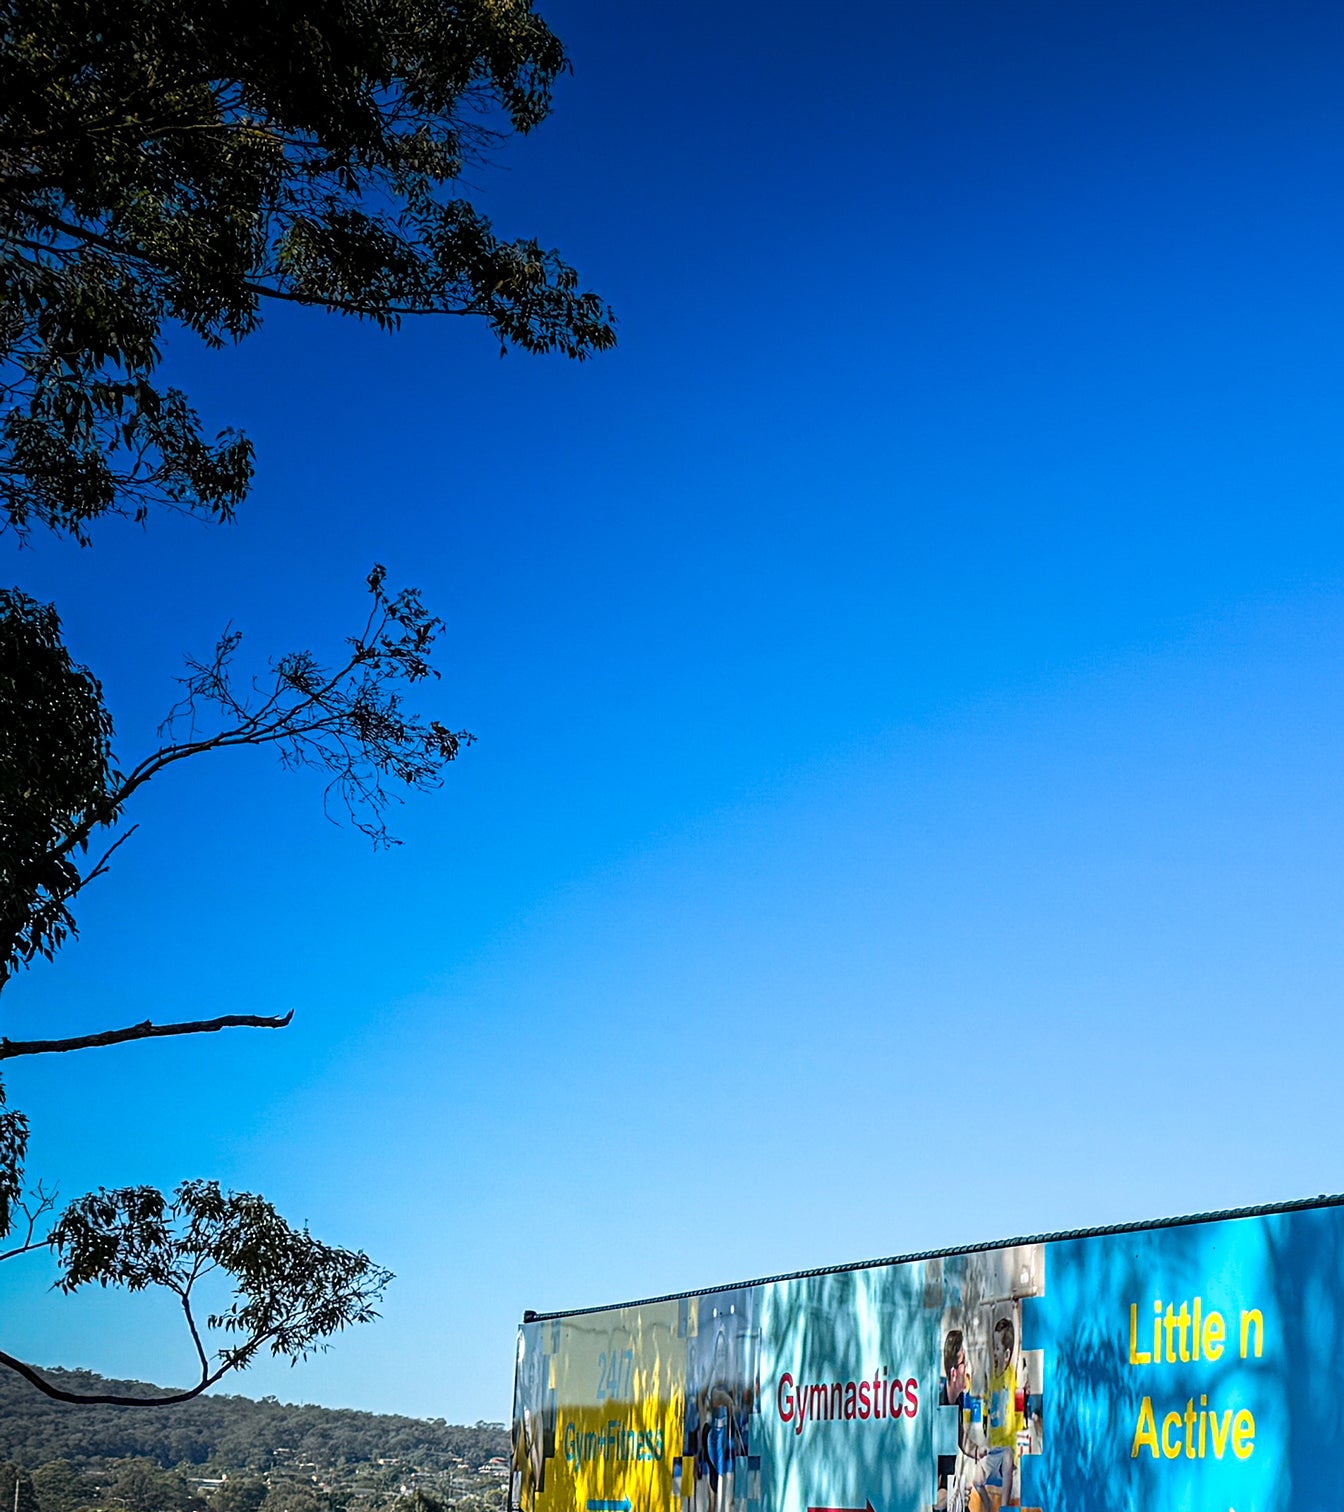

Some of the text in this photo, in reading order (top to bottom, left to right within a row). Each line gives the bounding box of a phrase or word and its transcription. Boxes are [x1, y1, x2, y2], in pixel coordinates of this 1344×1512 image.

[1129, 1298, 1264, 1365] Little n
[595, 1348, 634, 1400] 24/7
[777, 1366, 919, 1436] Gymnastics
[1130, 1396, 1255, 1459] Active
